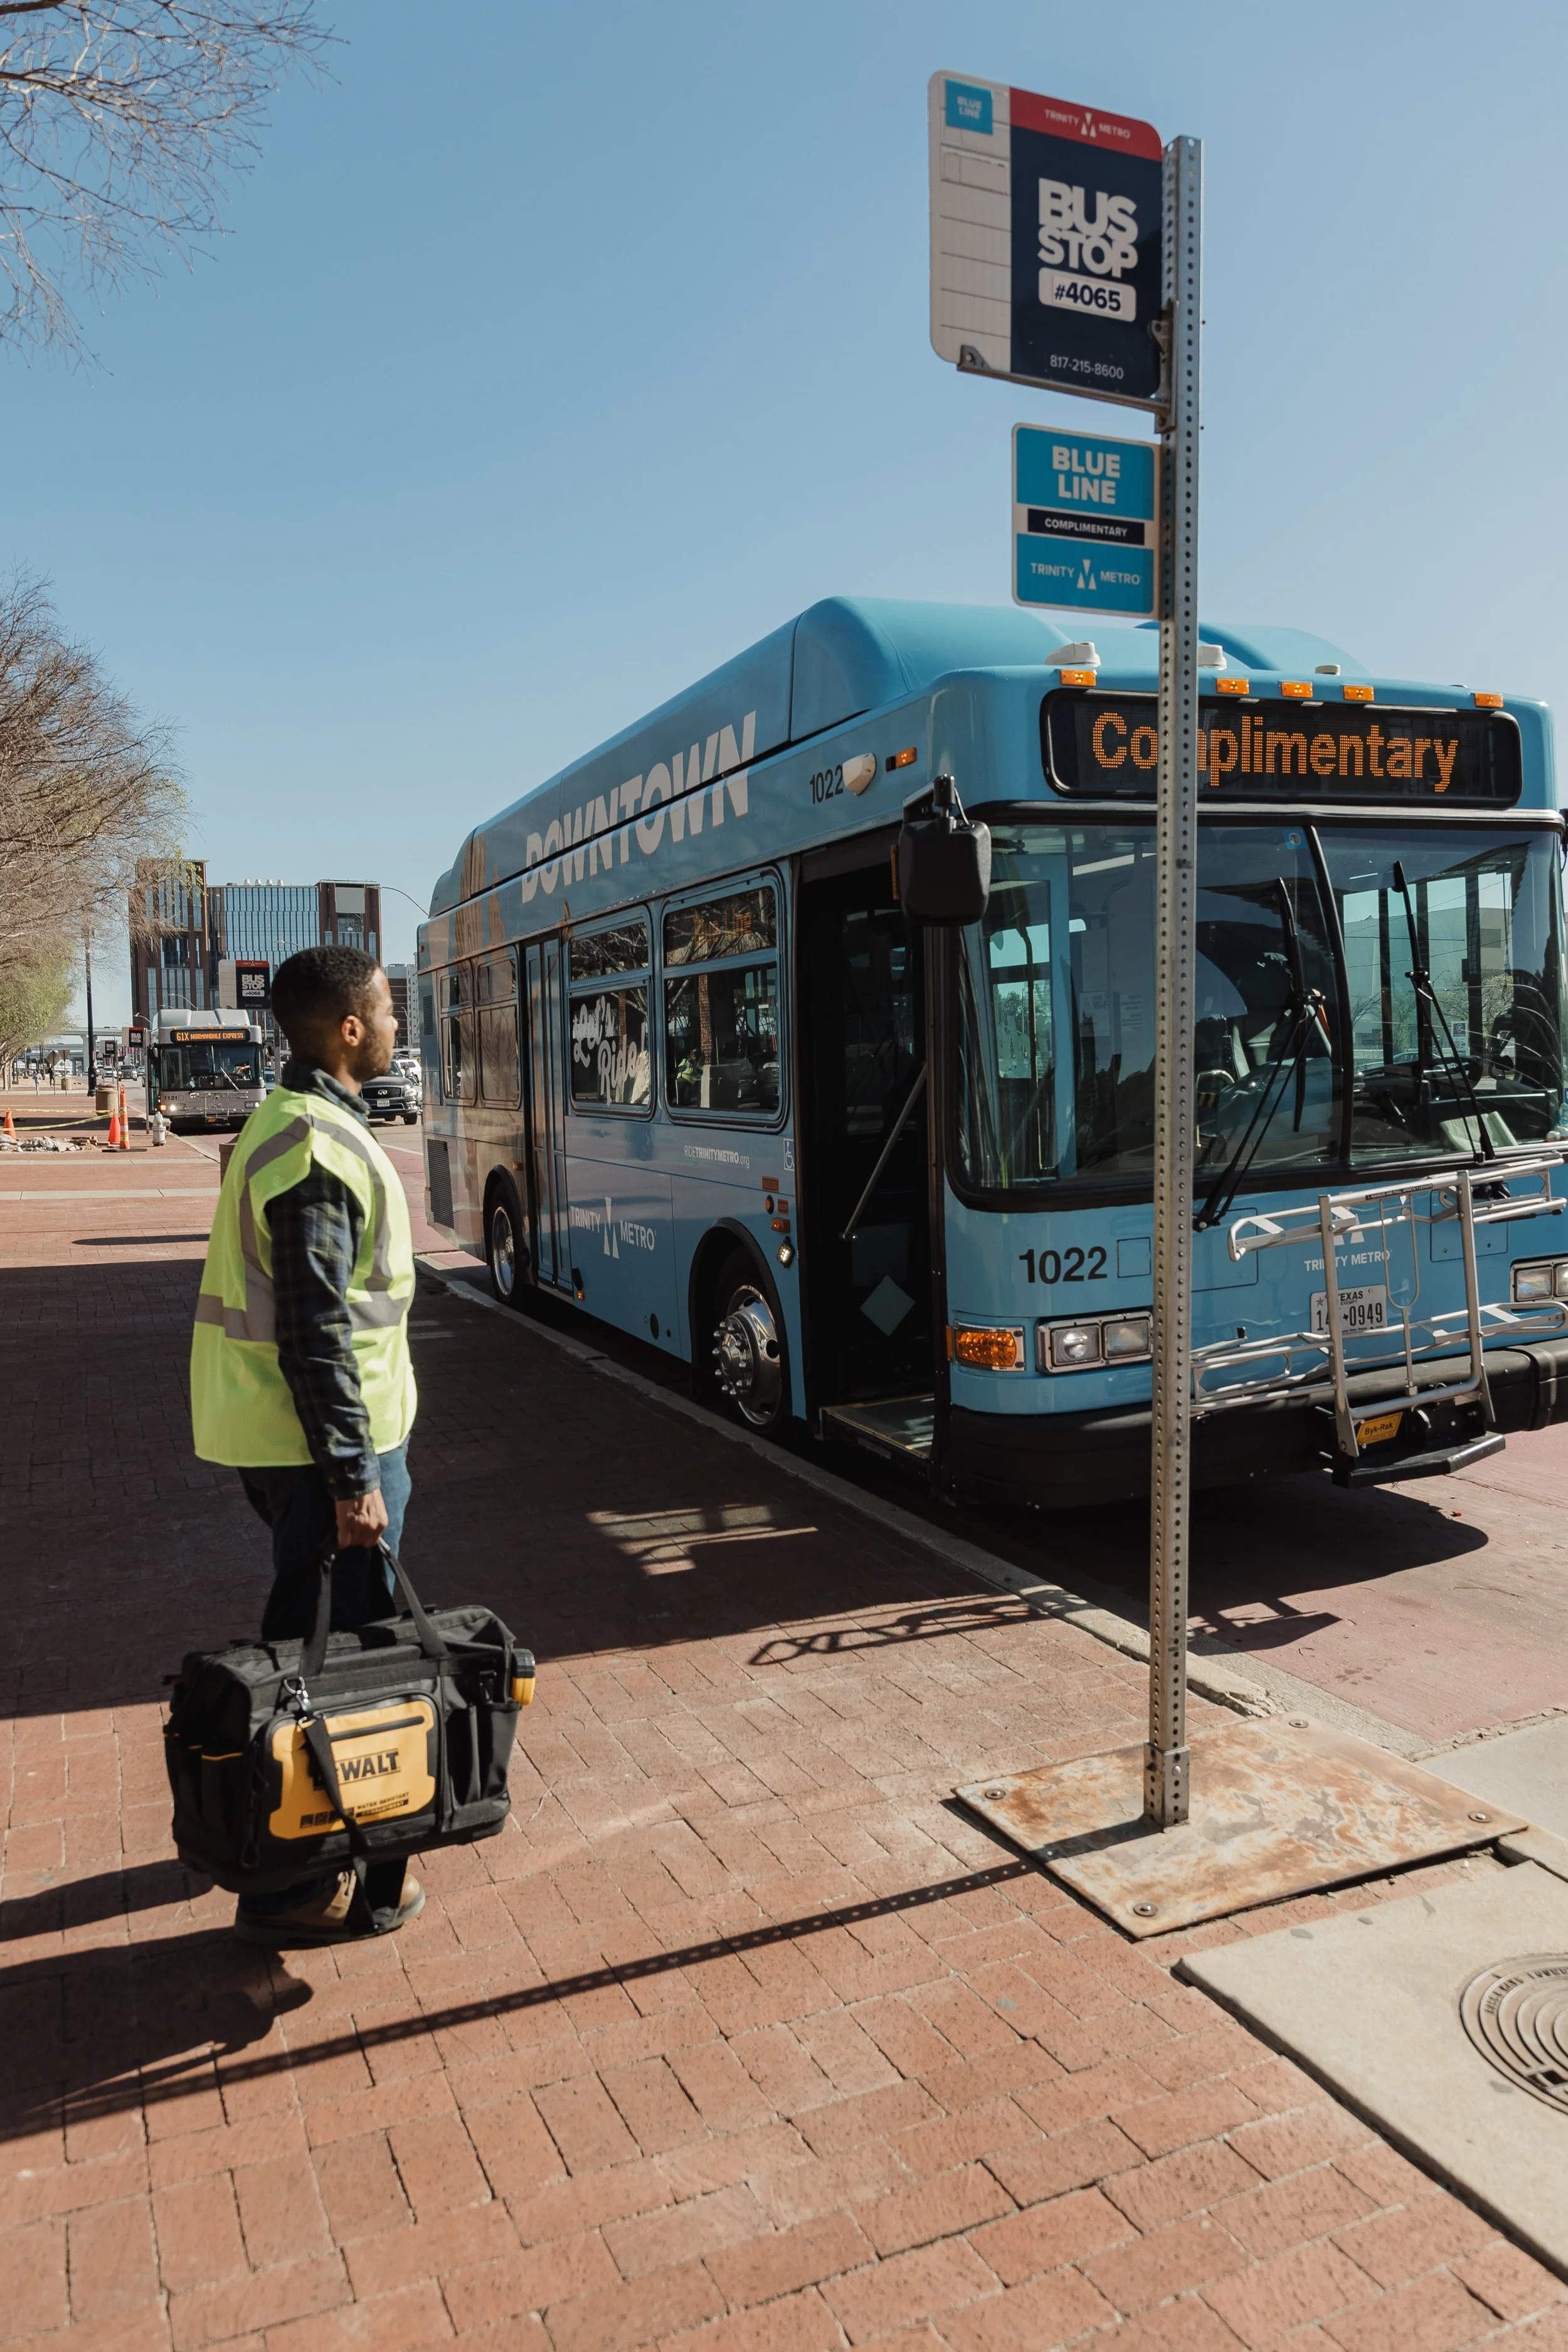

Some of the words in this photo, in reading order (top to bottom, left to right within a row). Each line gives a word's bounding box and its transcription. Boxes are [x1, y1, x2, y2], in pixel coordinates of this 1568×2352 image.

[957, 95, 982, 112] BLUE
[958, 107, 980, 119] LINE
[1044, 108, 1079, 126] TRINITY
[1099, 123, 1131, 139] METRO
[1038, 177, 1138, 245] BUS
[1037, 224, 1138, 278] STOP
[1054, 281, 1121, 312] #4065
[1049, 354, 1124, 379] 817-215-8600
[1052, 445, 1121, 479] BLUE
[1058, 474, 1116, 504] LINE
[1044, 517, 1128, 538] COMPLIMENTARY
[1030, 562, 1074, 578] TRINITY
[1100, 570, 1141, 585] METRO
[1092, 712, 1459, 793] Coplimentary
[809, 764, 844, 804] 1022
[521, 709, 757, 904] DOWNTOWN
[241, 974, 265, 983] BUS
[176, 1032, 189, 1041] 61X
[573, 995, 615, 1067] Let's
[597, 1019, 647, 1106] Ride!
[684, 1145, 750, 1169] RIDETRINITYMETRO.org
[569, 1205, 601, 1233] TRINITY
[620, 1219, 655, 1251] METRO
[1019, 1246, 1108, 1285] 1022
[1304, 1254, 1348, 1272] TRITY
[1351, 1249, 1391, 1266] METRO
[1338, 1290, 1364, 1301] EXAS
[1349, 1302, 1383, 1327] 0949
[1364, 1422, 1393, 1436] Byk-Rak
